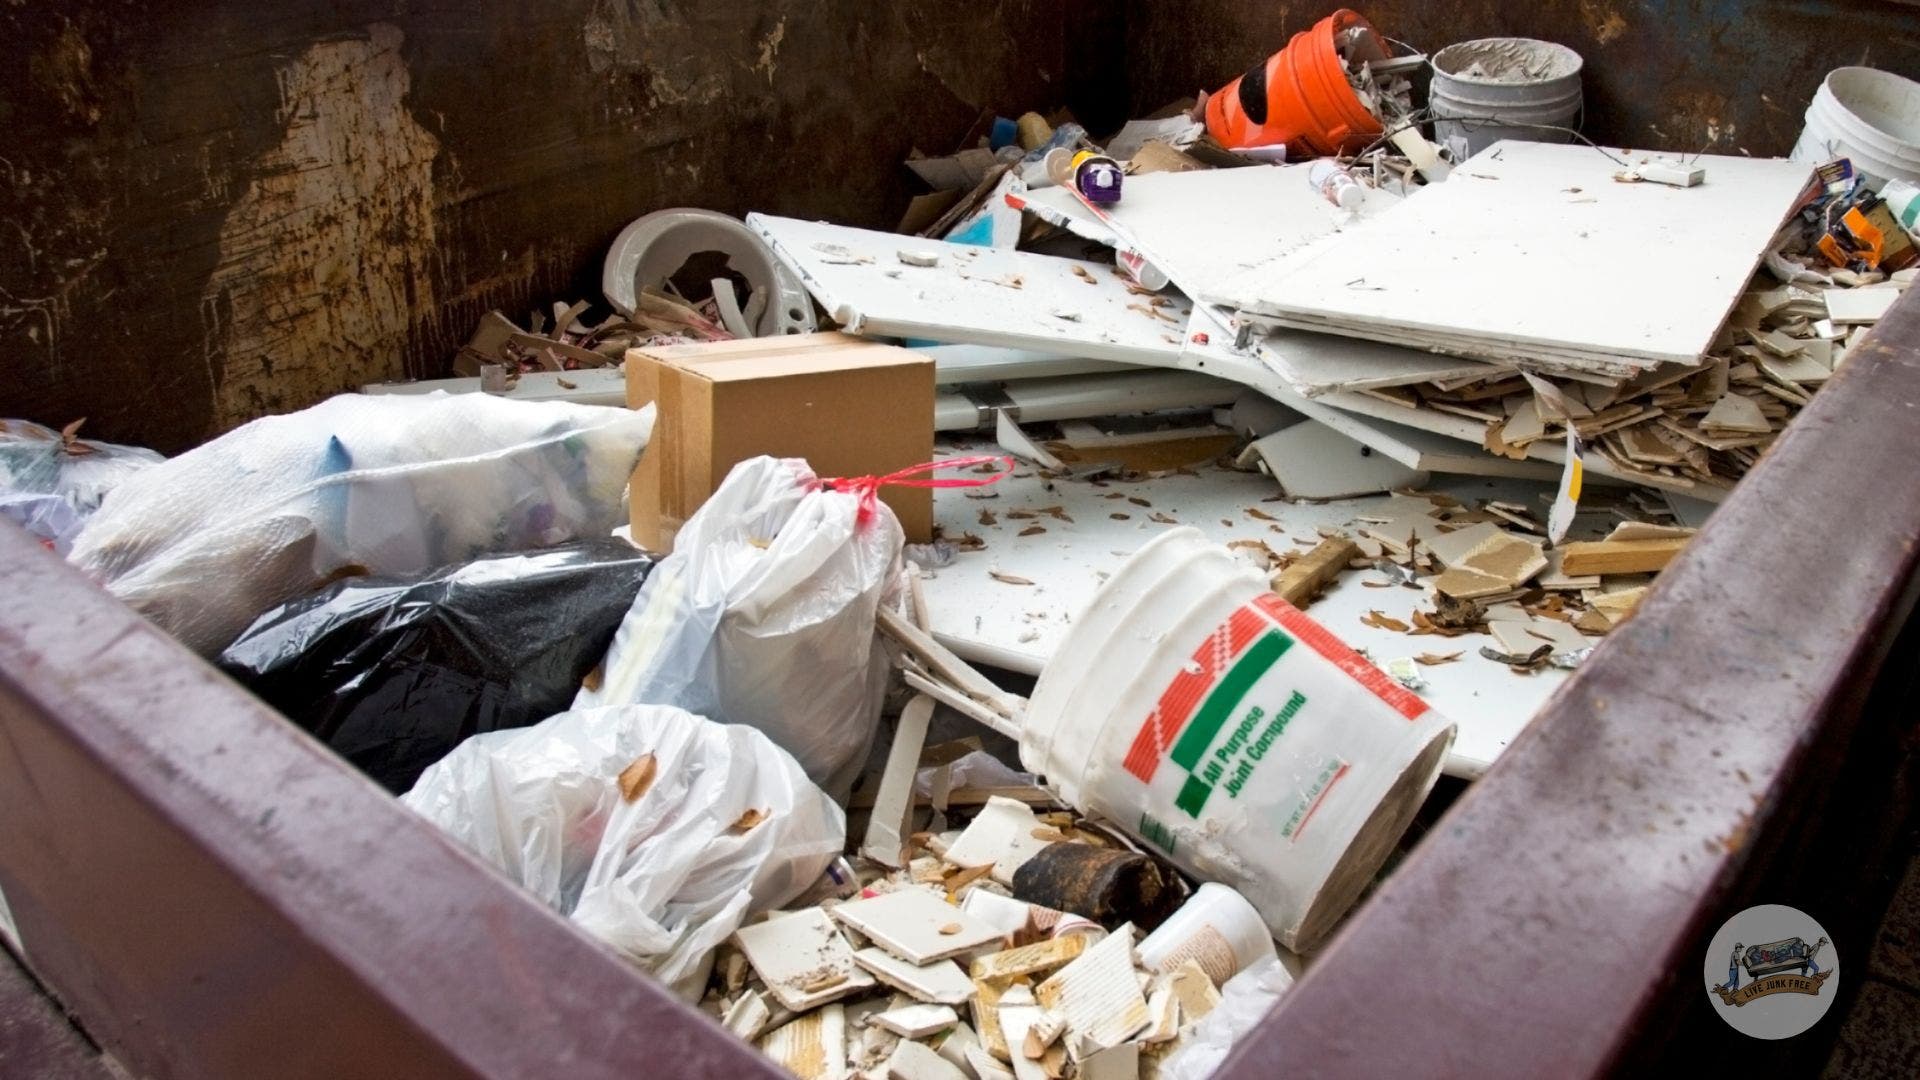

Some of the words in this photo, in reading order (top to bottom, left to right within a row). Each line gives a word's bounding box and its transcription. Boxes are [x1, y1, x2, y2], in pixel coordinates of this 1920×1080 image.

[1202, 760, 1224, 786] All
[1215, 706, 1265, 764] Purpose
[1223, 759, 1255, 799] Joint
[1246, 689, 1307, 761] Compound
